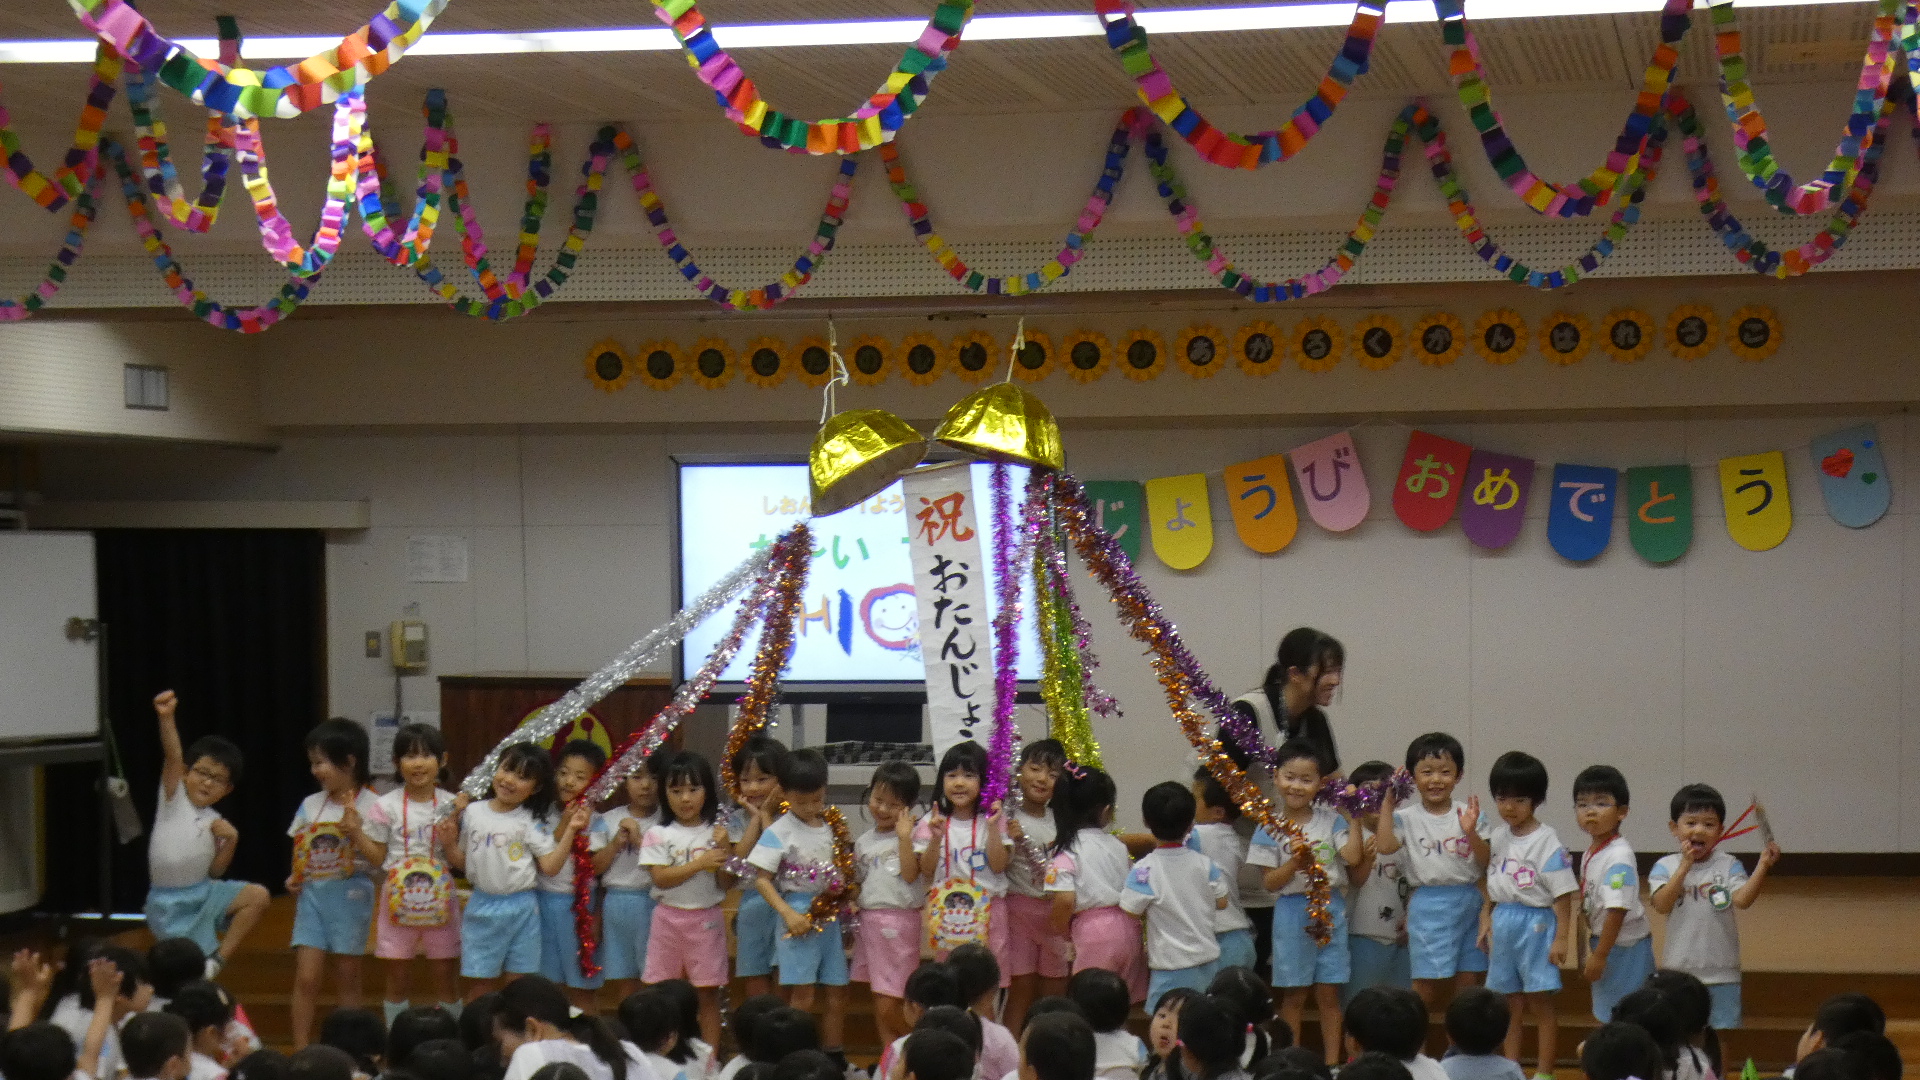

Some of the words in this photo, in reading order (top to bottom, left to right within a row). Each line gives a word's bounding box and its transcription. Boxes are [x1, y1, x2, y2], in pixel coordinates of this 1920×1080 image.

[1405, 453, 1773, 525] おめでとう
[929, 554, 980, 739] おたんじょ
